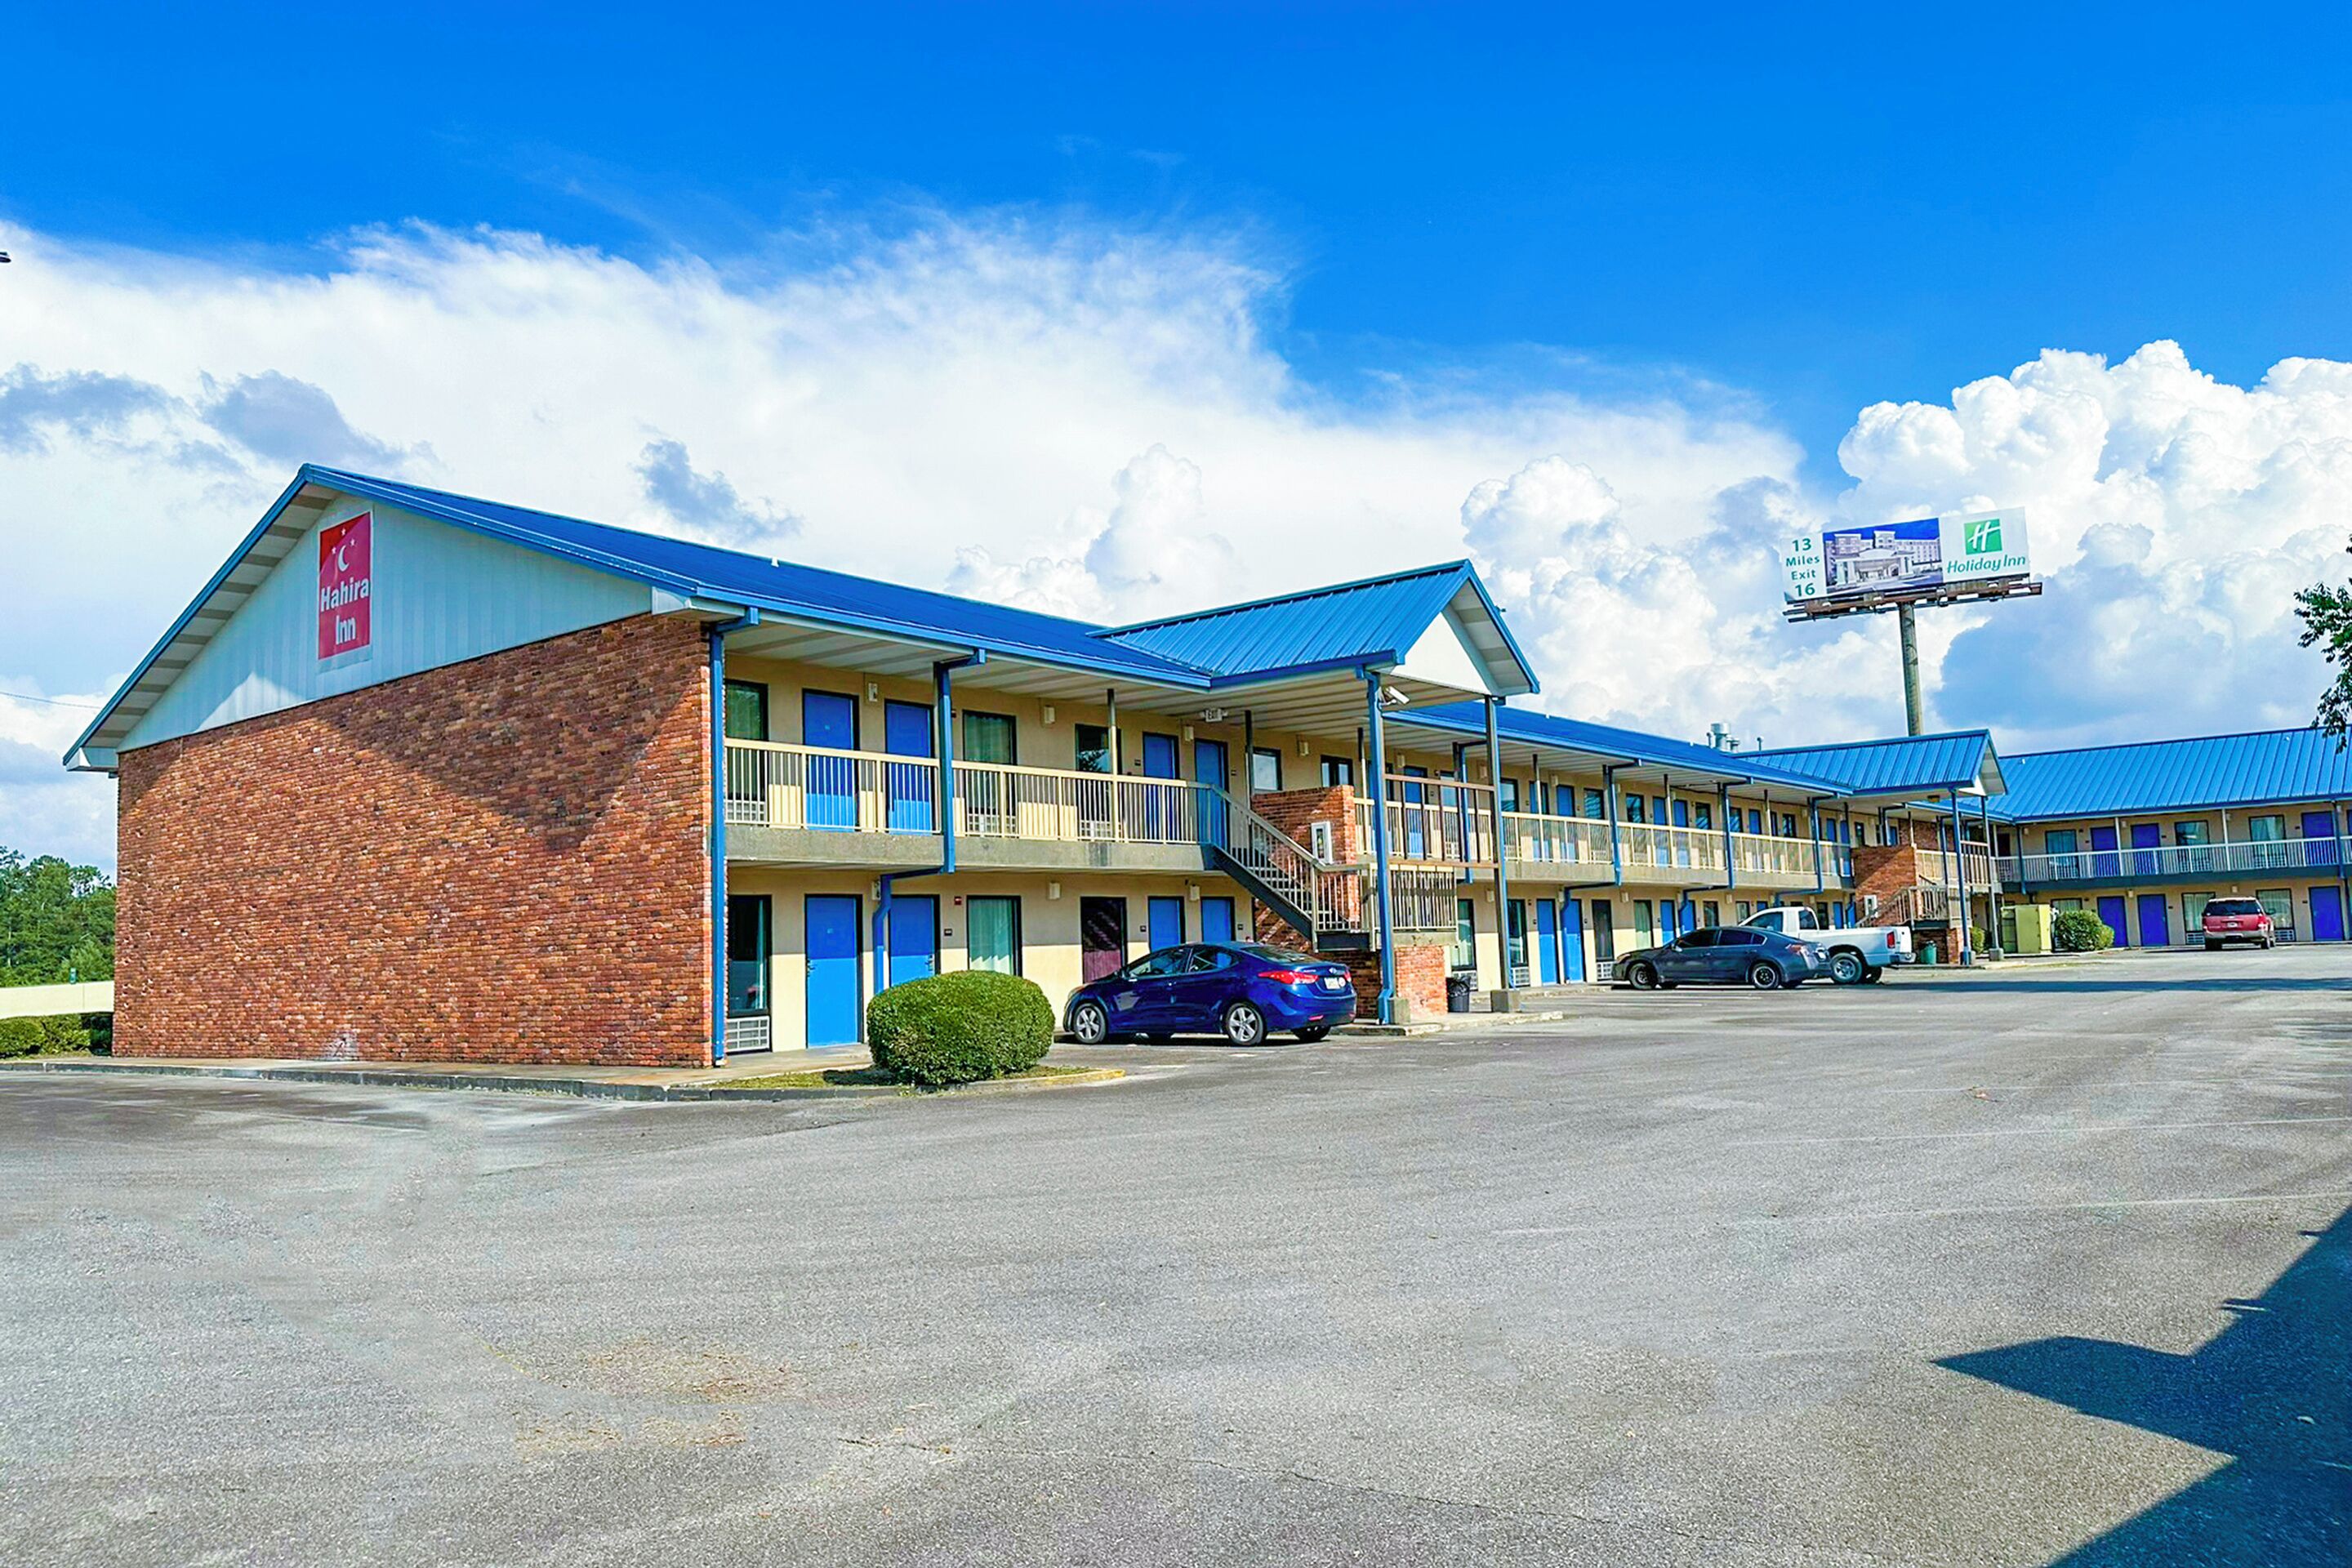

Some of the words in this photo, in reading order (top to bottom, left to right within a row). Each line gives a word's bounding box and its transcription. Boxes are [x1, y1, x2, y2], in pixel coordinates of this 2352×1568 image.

[1792, 538, 1811, 552] 13
[1786, 555, 1820, 567] Miles
[1947, 558, 2002, 573] Holiday
[2003, 555, 2025, 567] Inn
[1791, 569, 1816, 581] Exit
[320, 577, 370, 612] Hahira
[1795, 582, 1815, 597] 16
[335, 615, 356, 644] Inn
